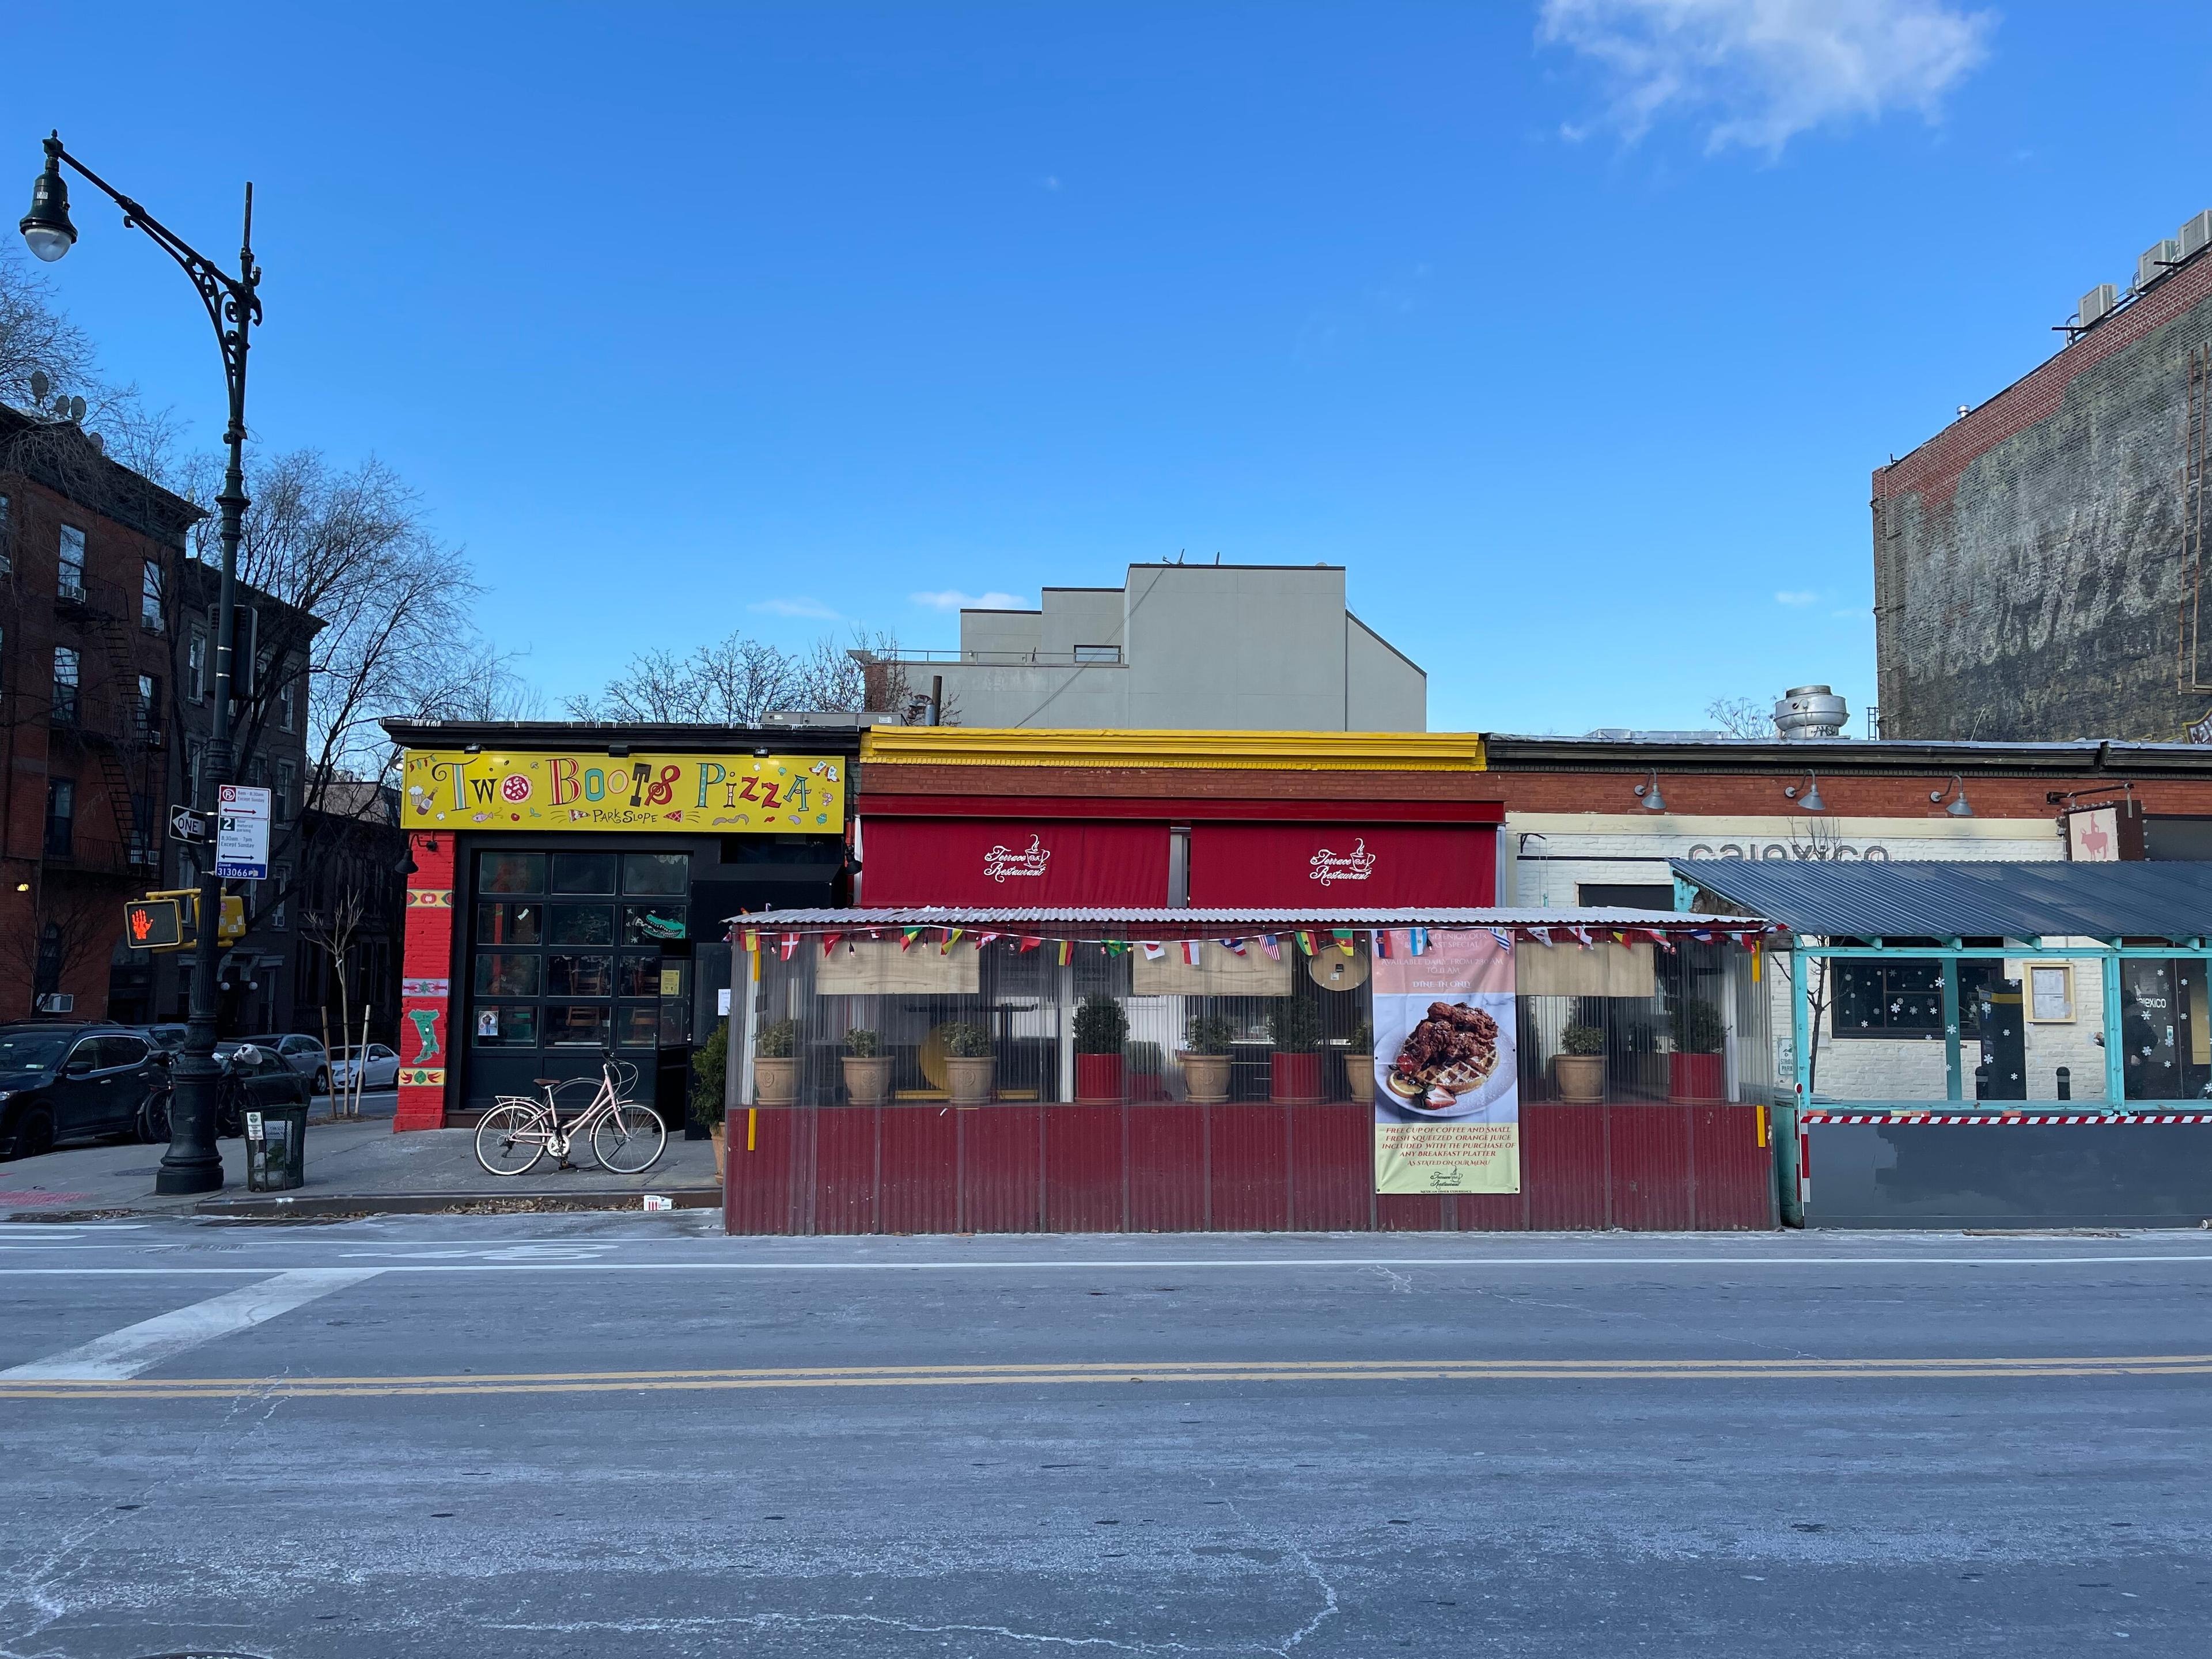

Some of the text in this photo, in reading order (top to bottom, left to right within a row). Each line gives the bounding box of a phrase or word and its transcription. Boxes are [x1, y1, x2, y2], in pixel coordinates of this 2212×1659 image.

[223, 818, 232, 830] 2
[593, 808, 658, 824] PARK SLOPE
[177, 817, 199, 833] ONE
[984, 846, 1026, 861] Terrace
[1310, 849, 1351, 865] Terrace
[217, 868, 247, 877] 313066
[983, 861, 1047, 883] Restaurant
[1309, 865, 1372, 887] Restaurant
[1449, 980, 1471, 988] ONLY
